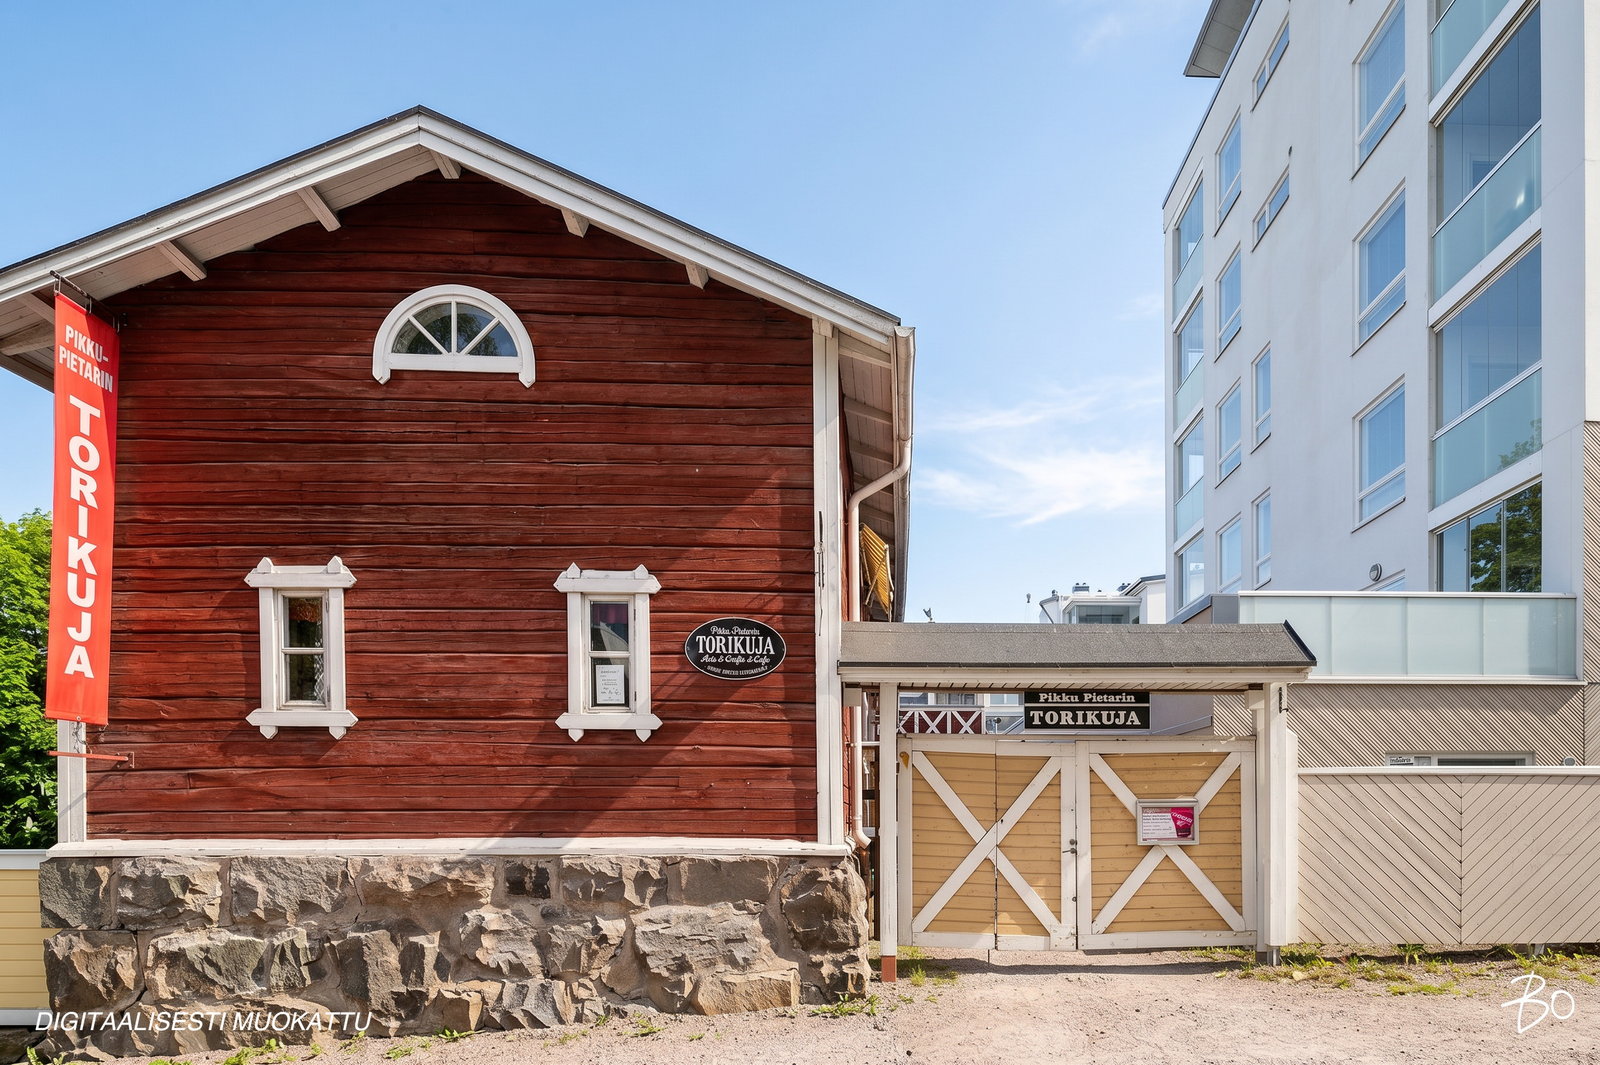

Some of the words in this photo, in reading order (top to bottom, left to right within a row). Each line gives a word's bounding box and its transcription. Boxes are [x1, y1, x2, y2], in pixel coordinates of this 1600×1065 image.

[64, 324, 110, 364] PIKKU-
[59, 344, 113, 393] PIETARIN
[64, 394, 101, 679] TORIKUJA
[695, 635, 775, 654] TORIKUJA
[1039, 692, 1079, 702] Pikku
[1083, 692, 1135, 702] Pietarin
[1029, 710, 1141, 725] TORIKUJA
